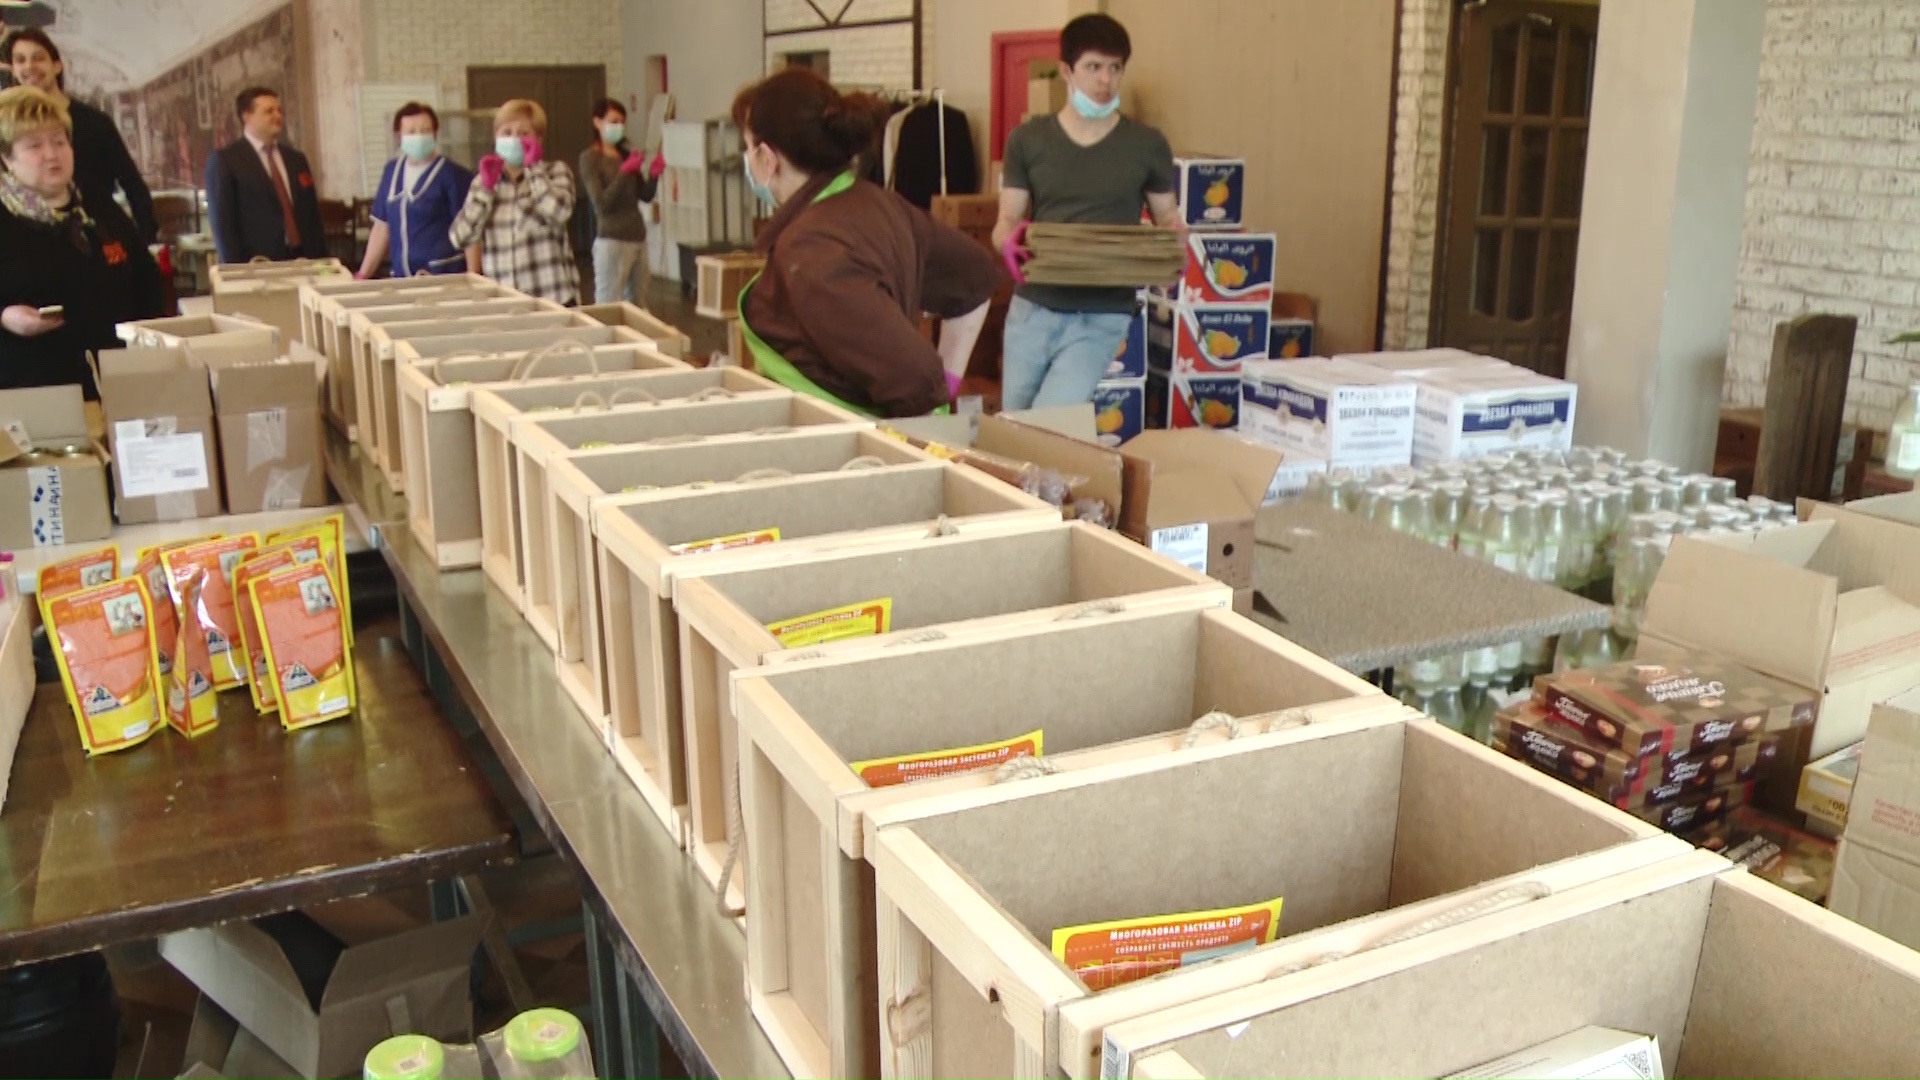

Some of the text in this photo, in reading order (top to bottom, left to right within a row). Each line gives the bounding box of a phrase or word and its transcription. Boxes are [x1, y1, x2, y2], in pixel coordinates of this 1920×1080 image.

[1183, 919, 1227, 934] ЗАСТЕЖКА
[1228, 917, 1243, 928] ZIP
[1115, 943, 1156, 955] СОХРАНЯЕТ
[1158, 940, 1194, 951] СВЕЖЕСТЬ
